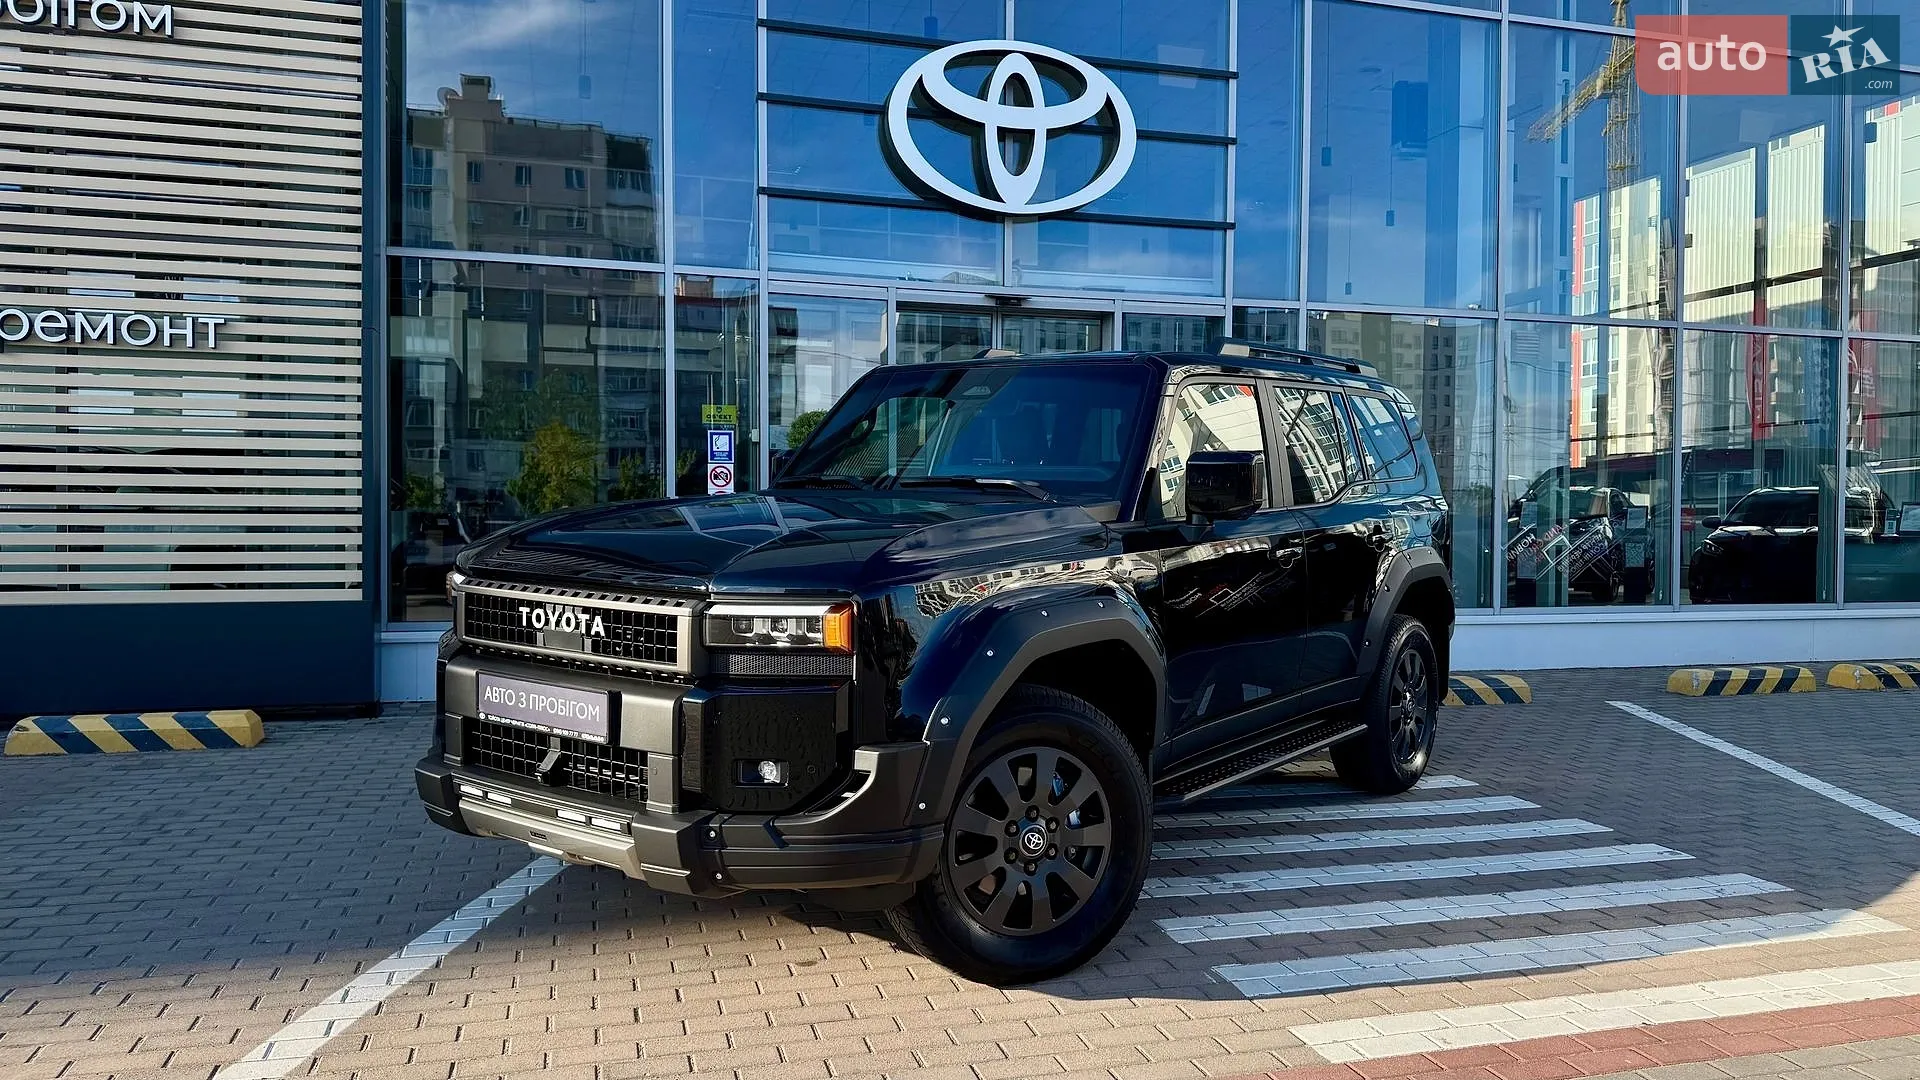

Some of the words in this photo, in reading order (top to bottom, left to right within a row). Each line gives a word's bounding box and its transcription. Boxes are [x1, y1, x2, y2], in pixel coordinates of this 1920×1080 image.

[519, 606, 606, 638] TOYOTA
[484, 686, 516, 706] АВТО
[529, 693, 600, 722] ПРОБІГОМ
